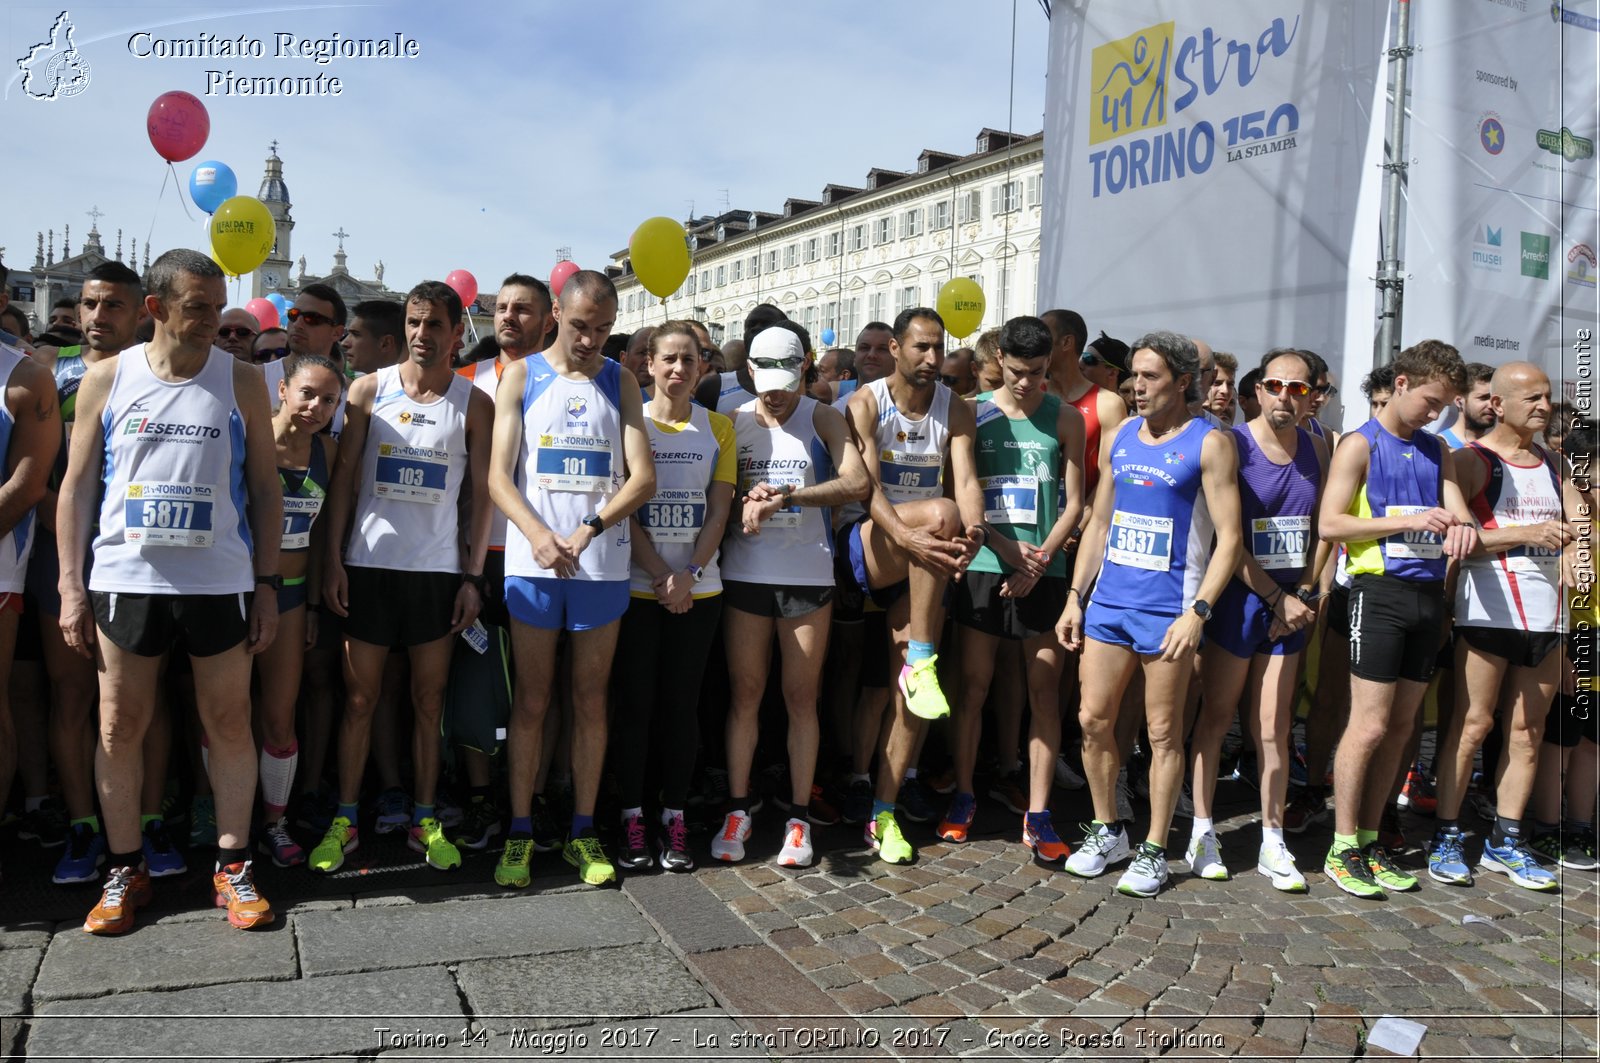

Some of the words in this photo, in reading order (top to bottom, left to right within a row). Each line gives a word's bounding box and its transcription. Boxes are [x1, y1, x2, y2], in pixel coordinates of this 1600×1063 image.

[1174, 14, 1300, 114] Stra
[1476, 70, 1508, 89] sponsored
[1510, 77, 1518, 92] by
[1223, 103, 1299, 146] 150
[1089, 120, 1215, 198] TORINO
[1227, 148, 1243, 163] LA
[1245, 137, 1297, 160] STAMPA
[1474, 335, 1494, 348] media
[1496, 338, 1520, 351] partner
[145, 423, 221, 439] ESERCITO
[562, 457, 586, 475] 101
[655, 452, 703, 461] ESERCITO
[750, 460, 808, 470] ESERCITO
[398, 467, 424, 486] 103
[899, 472, 920, 487] 105
[1121, 464, 1177, 487] INTERFORZE
[994, 494, 1015, 510] 104
[1506, 496, 1557, 508] POLISPORTIVA
[142, 501, 195, 529] 5877
[648, 504, 694, 527] 5883
[1117, 528, 1155, 555] 5837
[1267, 531, 1304, 554] 7206
